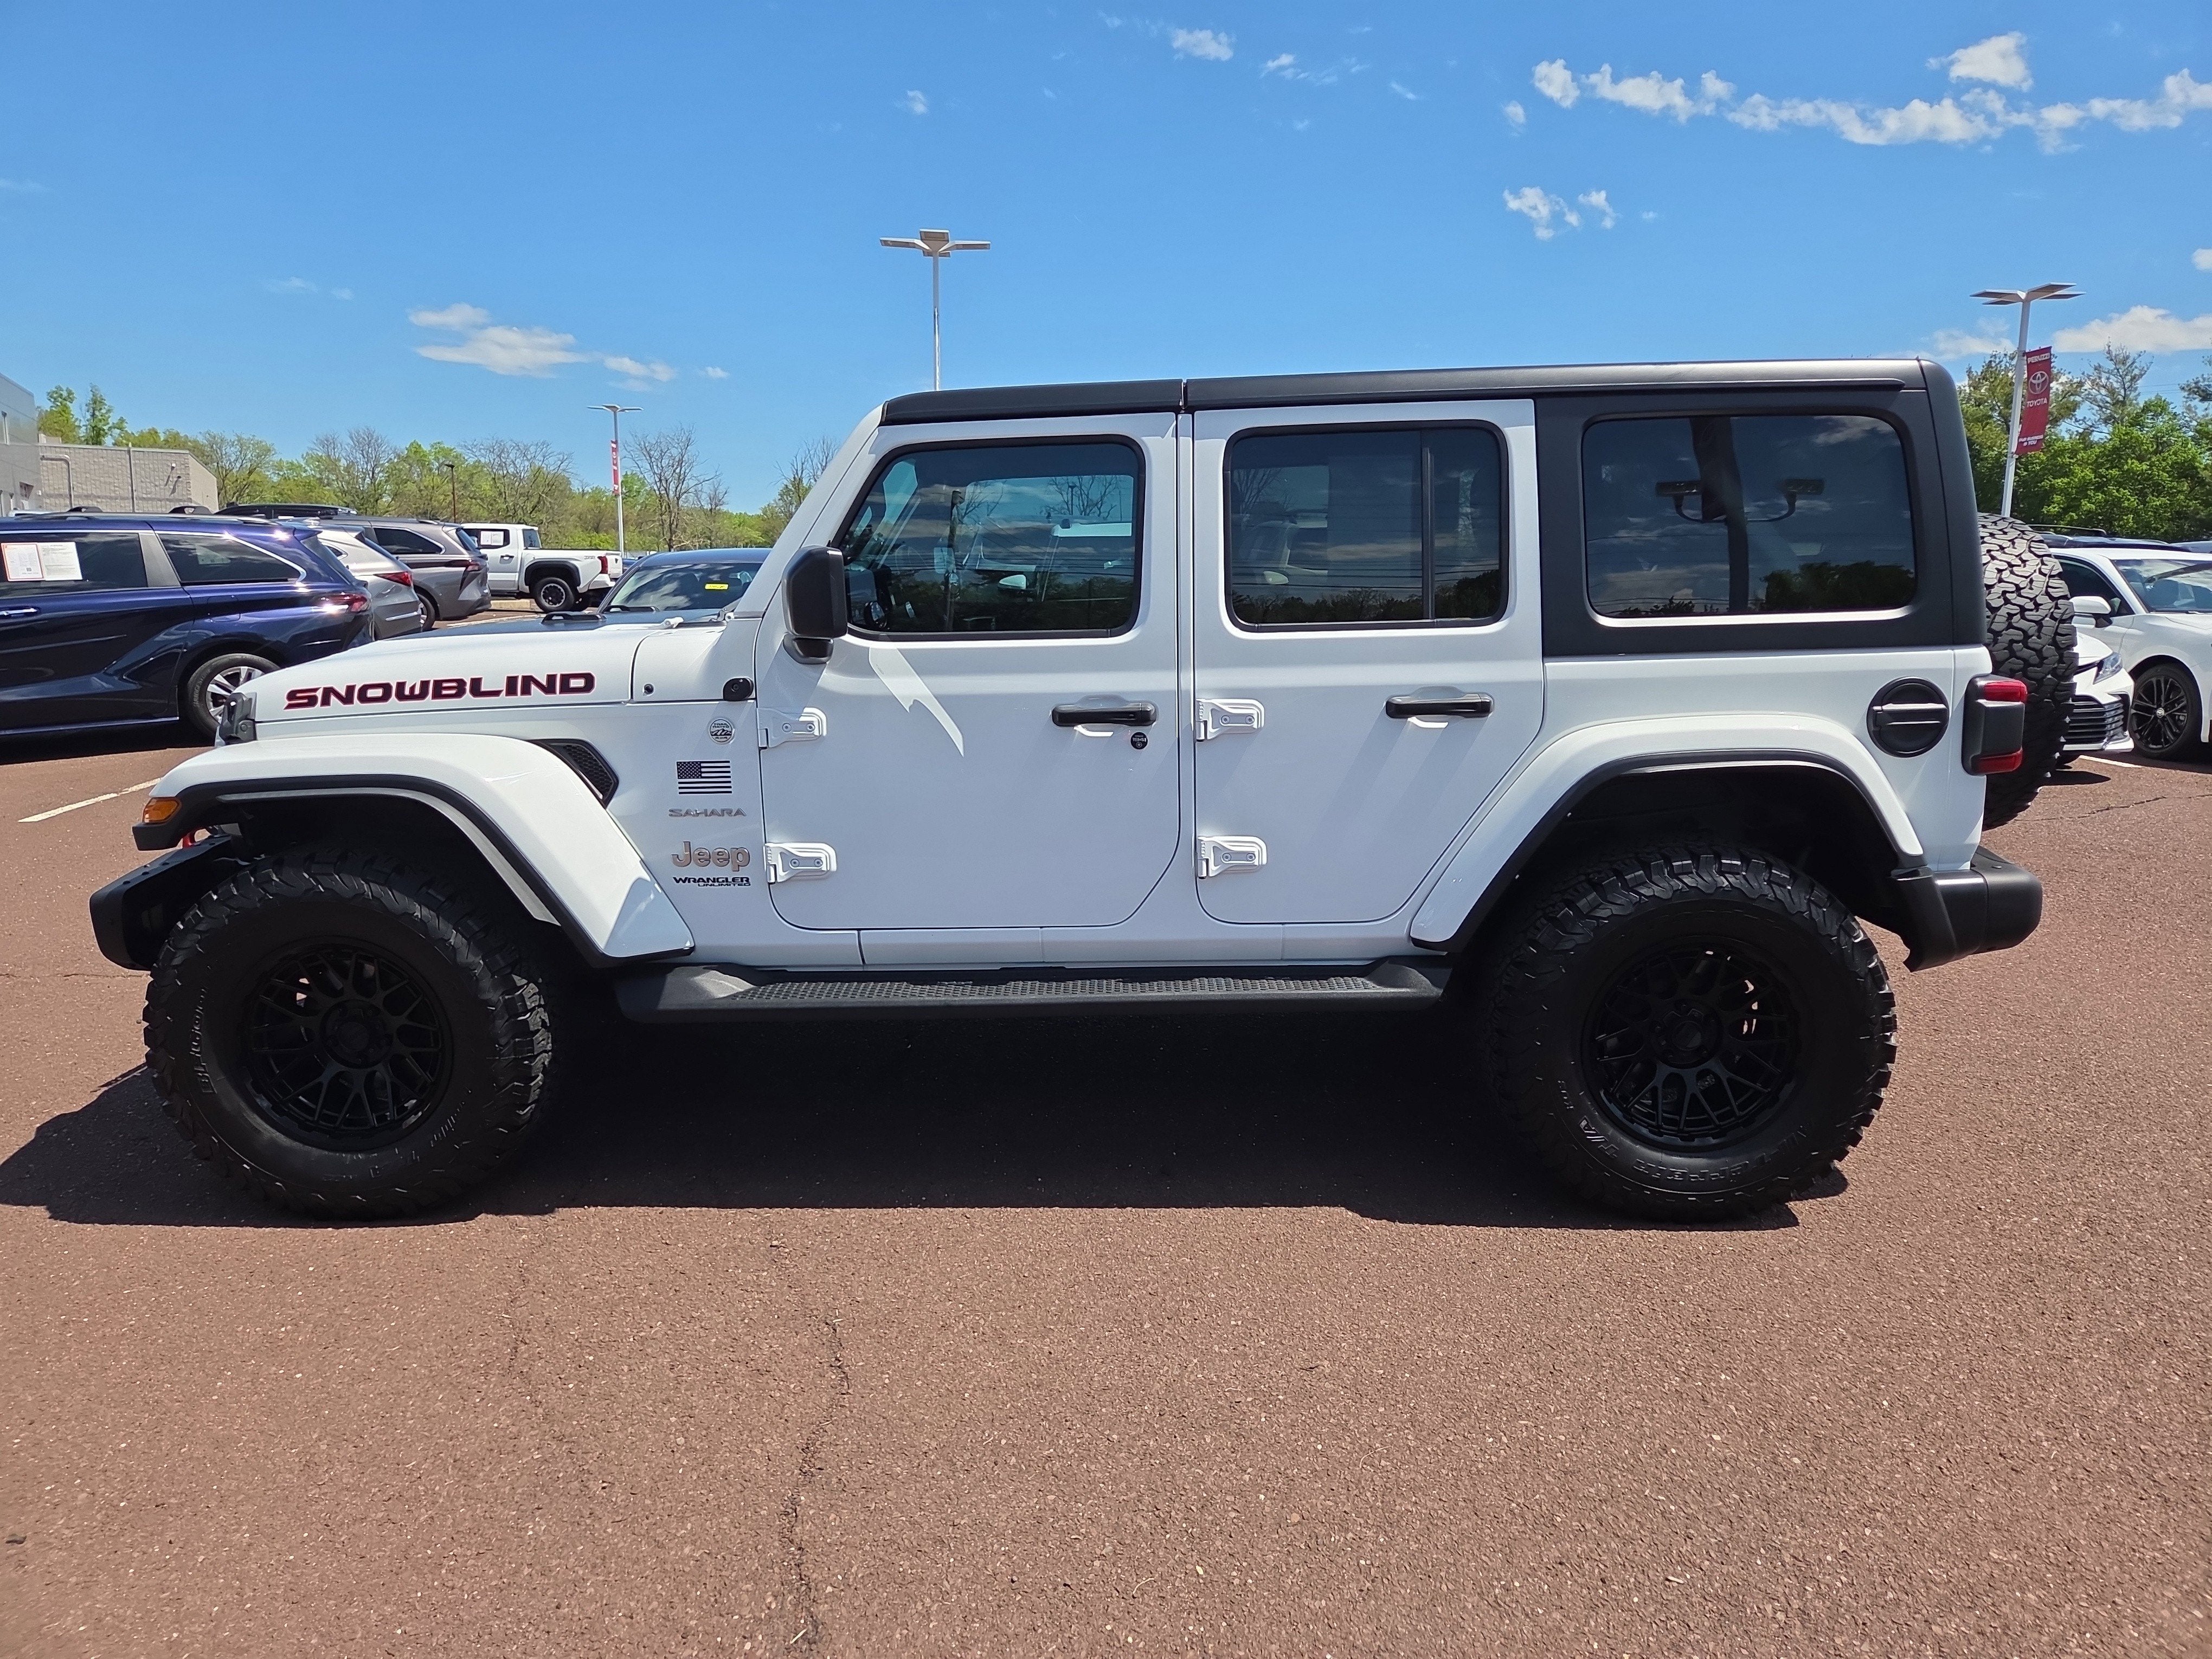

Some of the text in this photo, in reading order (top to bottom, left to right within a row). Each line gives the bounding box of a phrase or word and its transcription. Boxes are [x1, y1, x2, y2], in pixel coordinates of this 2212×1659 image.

[2027, 397, 2048, 407] TOYOTA
[284, 672, 595, 710] SNOWBLIND
[668, 808, 747, 817] SAHARA
[671, 841, 750, 872] Jeep
